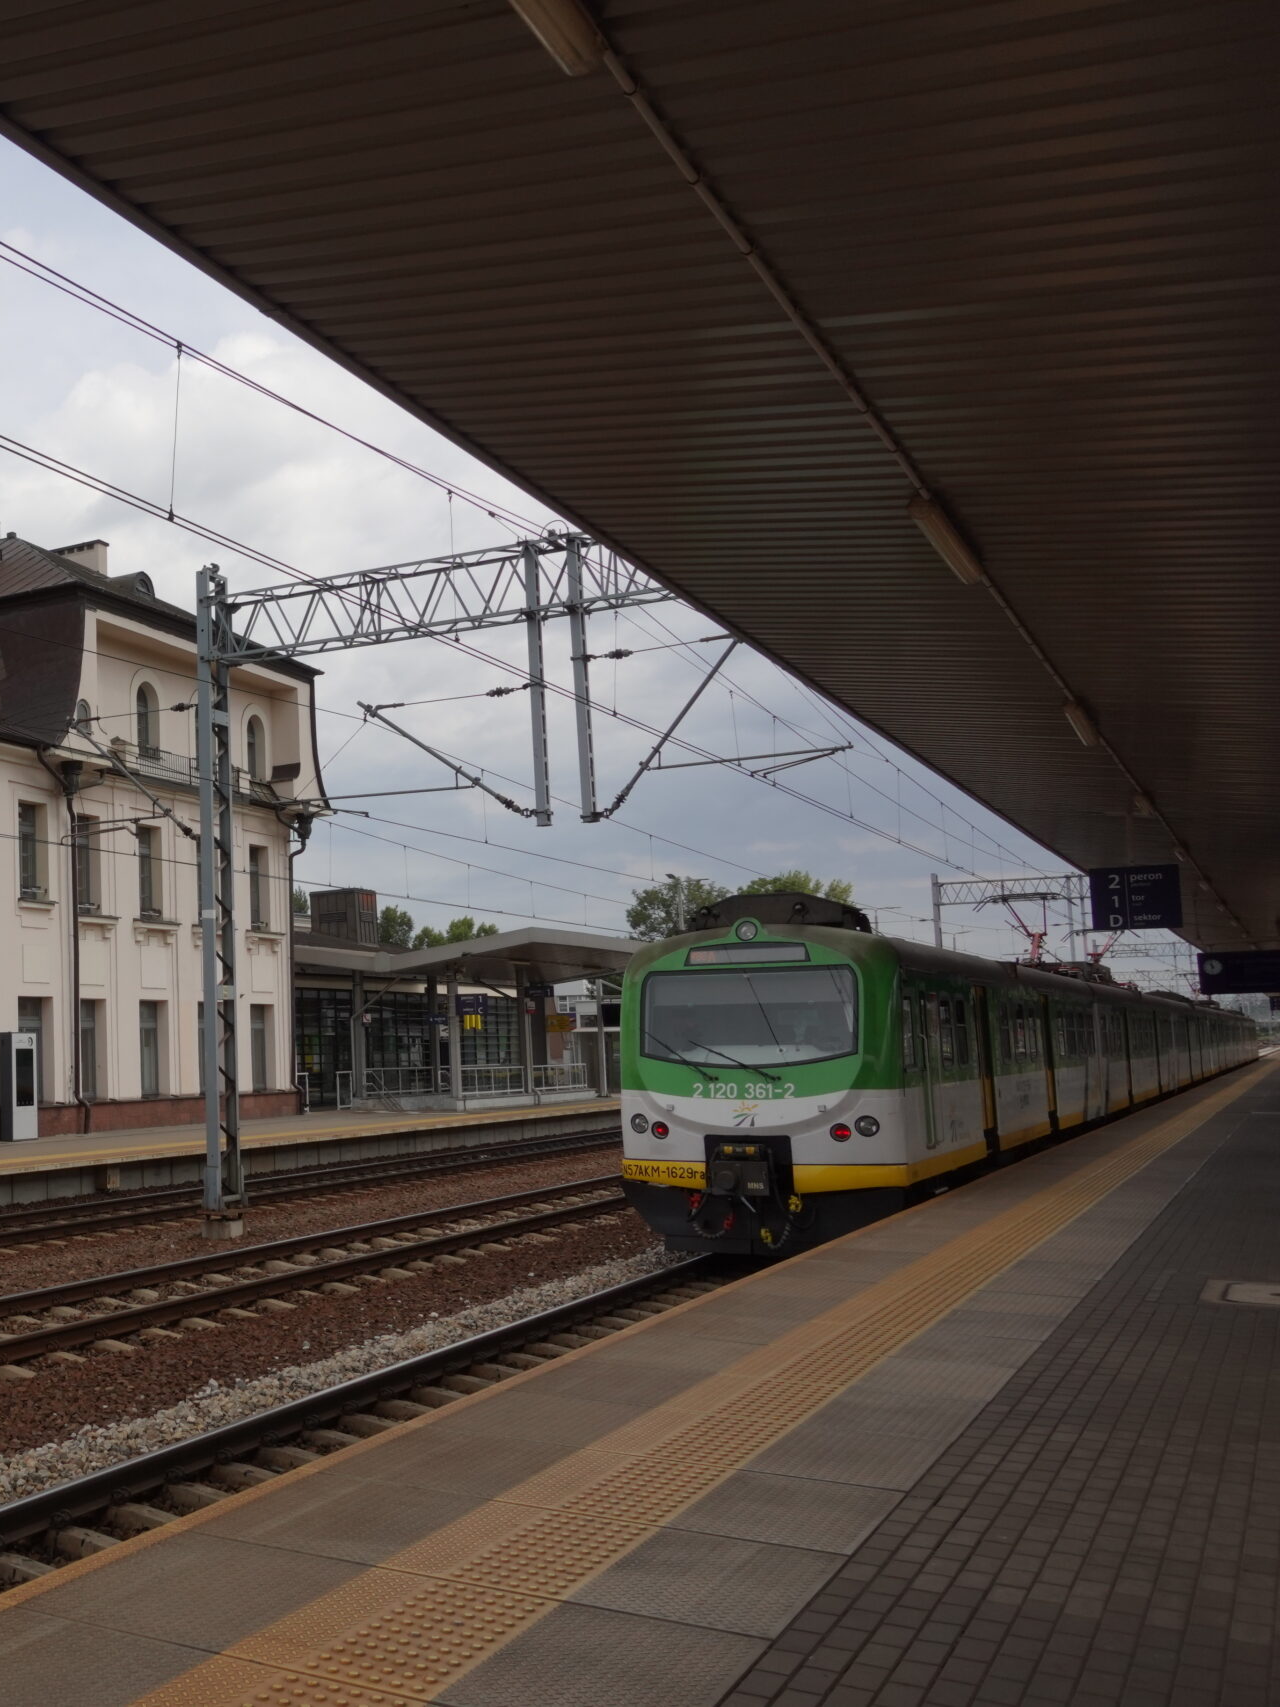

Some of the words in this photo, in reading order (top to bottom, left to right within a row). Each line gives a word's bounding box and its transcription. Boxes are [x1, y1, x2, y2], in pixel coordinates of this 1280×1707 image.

[1108, 874, 1120, 888] 2
[1130, 873, 1163, 882] peron
[1111, 895, 1119, 908] 1
[1109, 914, 1122, 927] D
[1133, 913, 1161, 921] sektor
[692, 1083, 703, 1098] 2
[708, 1083, 738, 1098] 120
[744, 1083, 795, 1098] 361-2
